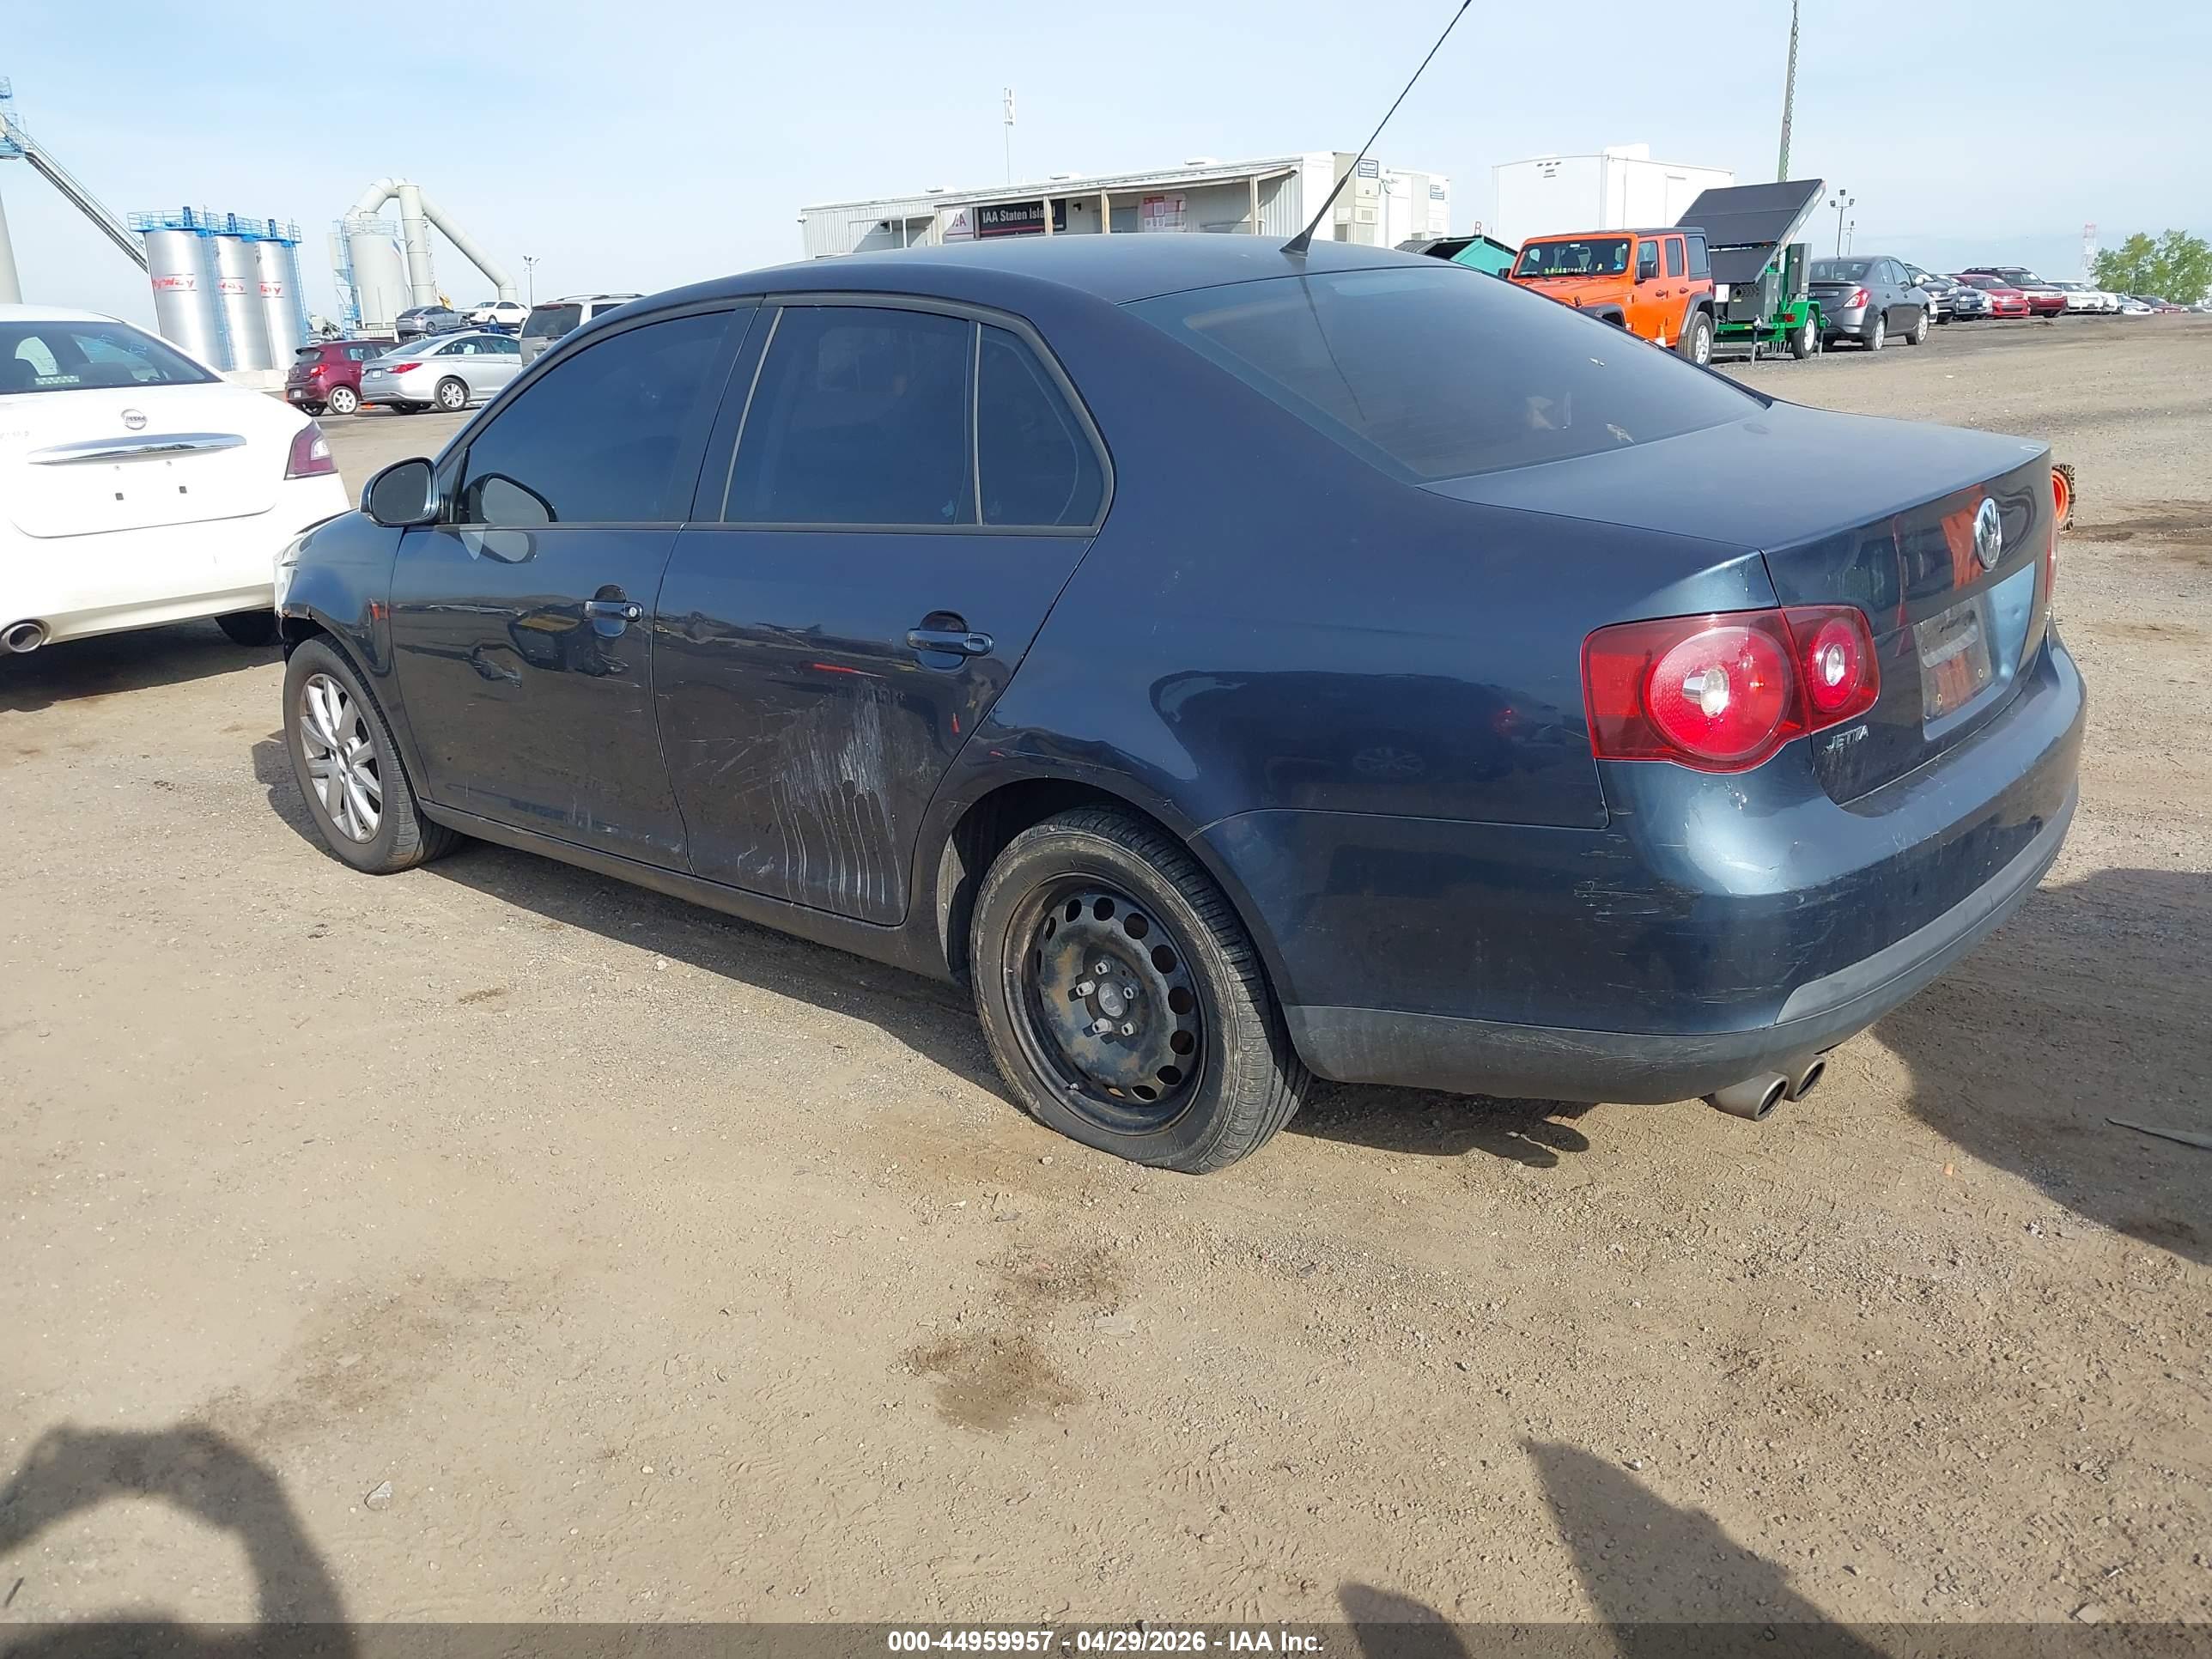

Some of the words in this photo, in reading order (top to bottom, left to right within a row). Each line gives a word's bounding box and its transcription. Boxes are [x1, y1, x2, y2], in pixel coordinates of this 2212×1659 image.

[982, 210, 999, 223] IAA
[1000, 209, 1027, 222] Staten
[1826, 725, 1869, 750] JETTA
